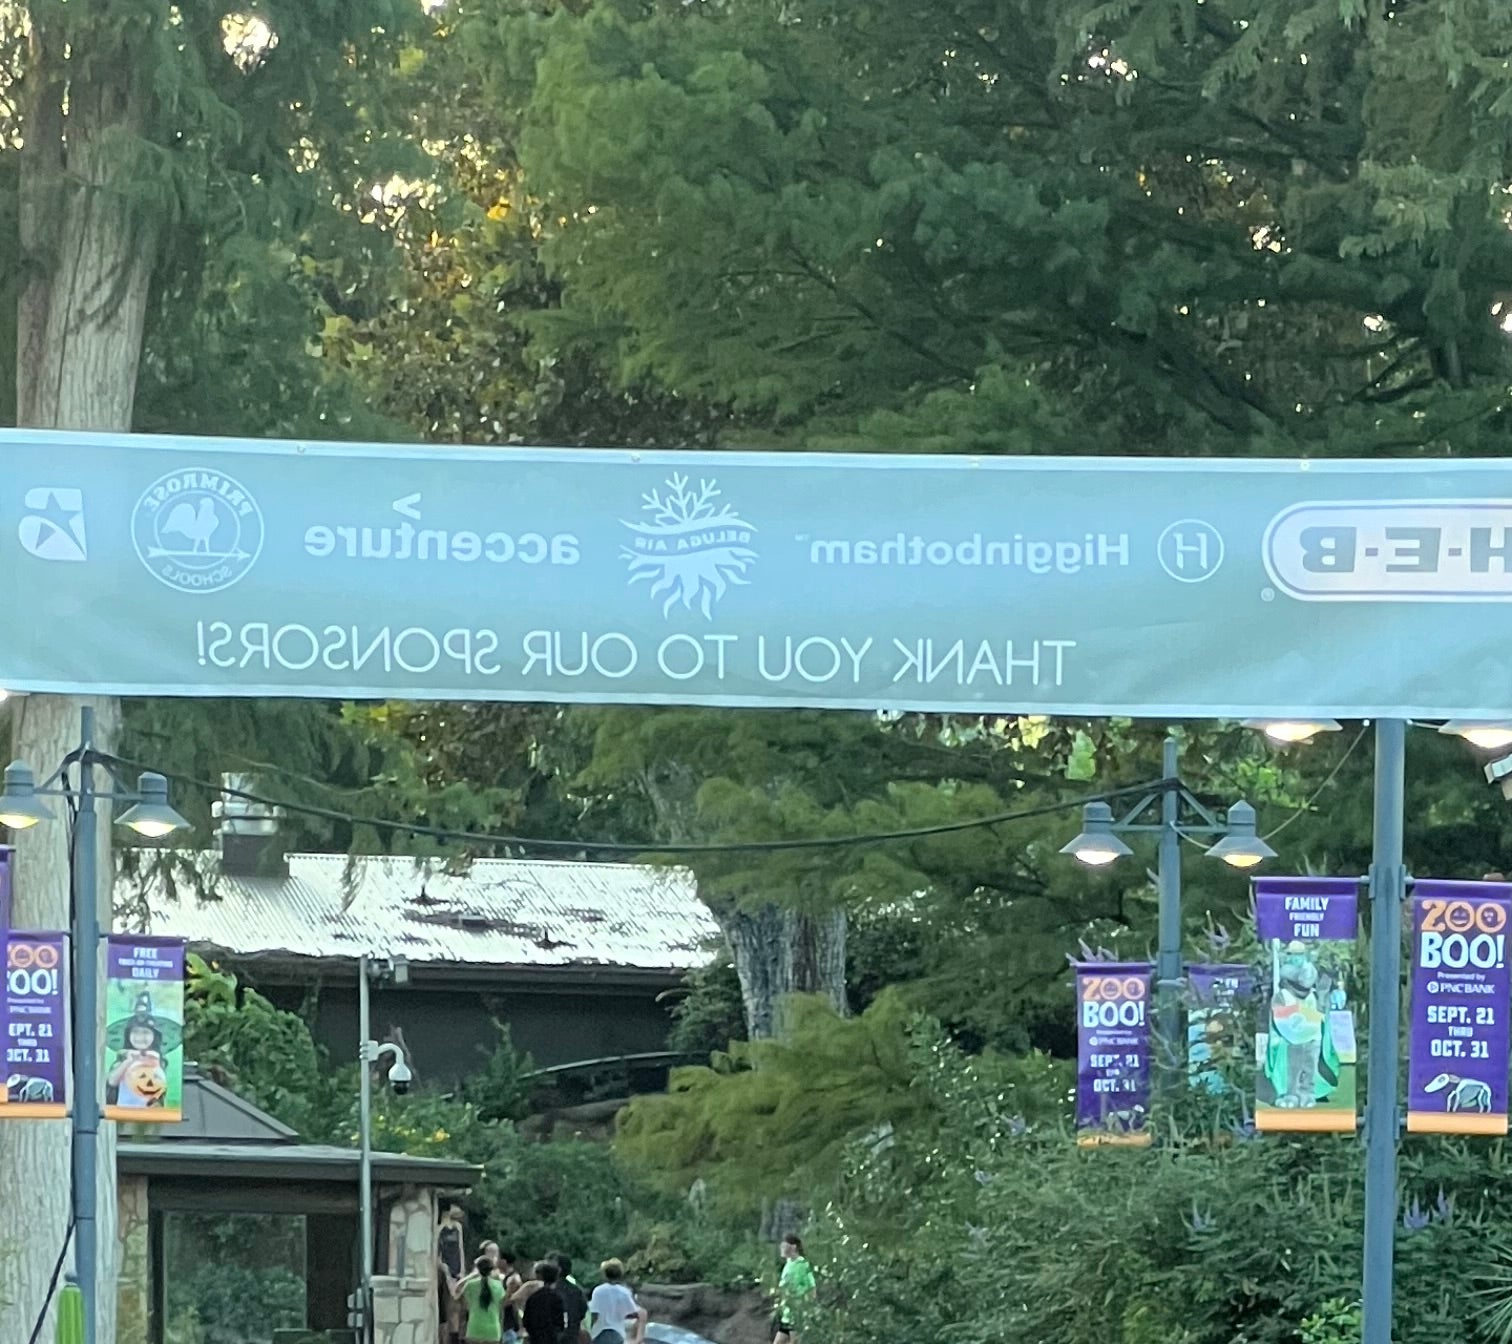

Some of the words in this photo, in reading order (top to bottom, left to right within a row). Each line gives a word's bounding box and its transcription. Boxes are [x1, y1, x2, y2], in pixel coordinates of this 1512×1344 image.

[1284, 896, 1330, 912] FAMILY
[1288, 911, 1325, 922] FRIENDLY
[1420, 899, 1508, 934] ZOO
[1293, 922, 1321, 938] FUN
[8, 943, 59, 969] OO
[132, 946, 159, 959] FREE
[1419, 931, 1506, 969] BOO!
[1437, 970, 1473, 981] Presented
[1474, 972, 1486, 983] by
[1082, 976, 1146, 1001] ZOO
[1082, 1000, 1146, 1028] BOO!
[1427, 1004, 1472, 1025] SEPT.
[1475, 1006, 1495, 1025] 21
[8, 1022, 36, 1038] EPT.
[1447, 1025, 1474, 1038] THRU
[1430, 1038, 1468, 1058] OCT.
[1470, 1039, 1490, 1059] 31
